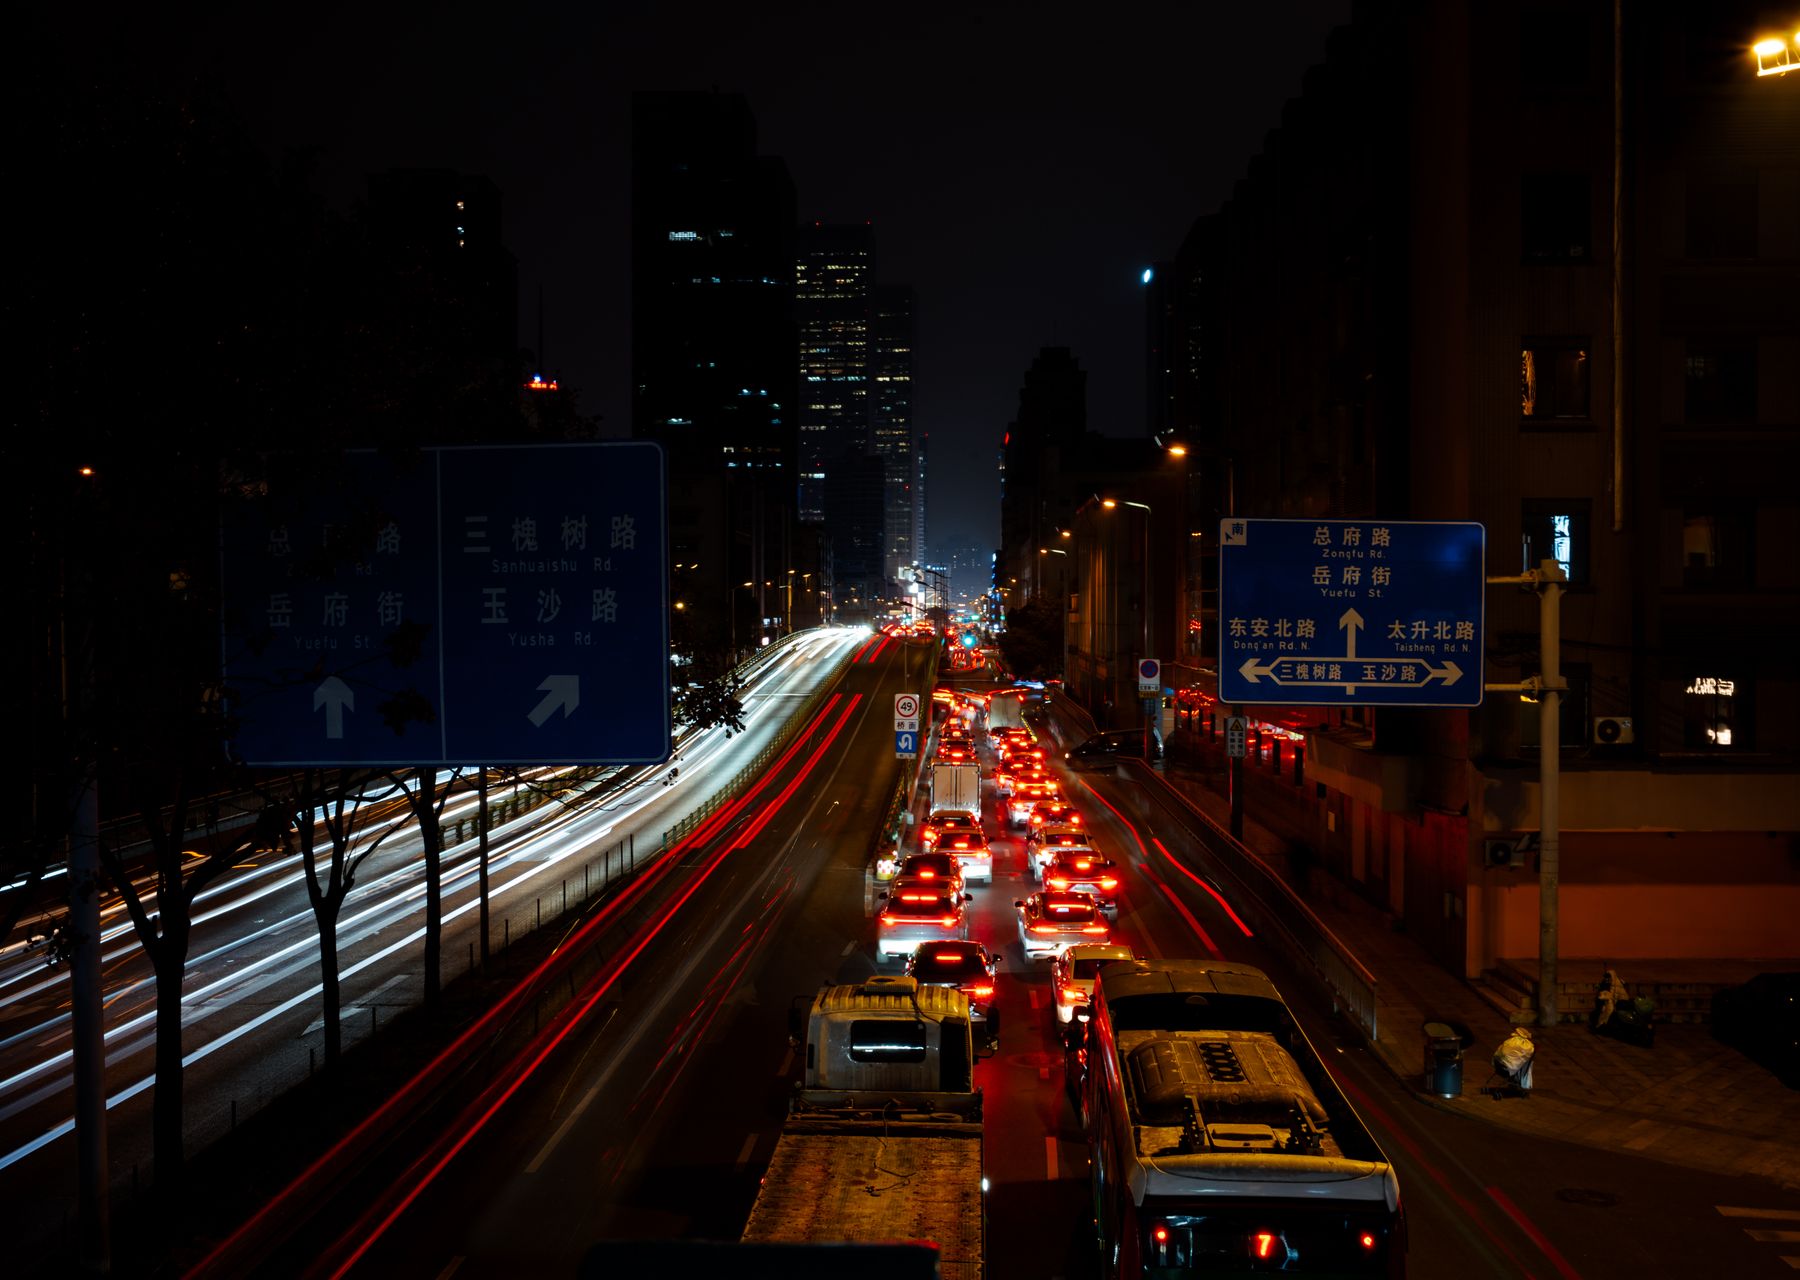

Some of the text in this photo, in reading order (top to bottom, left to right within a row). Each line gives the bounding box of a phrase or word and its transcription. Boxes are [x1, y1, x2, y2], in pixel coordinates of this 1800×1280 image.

[463, 513, 637, 553] 三槐树路
[1232, 523, 1244, 536] 南
[1312, 525, 1391, 547] 总府路
[1322, 549, 1387, 560] Zongfu Rd.
[491, 556, 618, 573] Sanhuaishu Rd.
[1312, 565, 1392, 586] 岳府街
[1320, 588, 1384, 598] Yuefu St.
[265, 591, 404, 628] 岳府街
[481, 586, 619, 624] 玉沙路
[1229, 617, 1317, 639] 东安北路
[1387, 619, 1475, 641] 太升北路
[294, 635, 337, 649] Yuefu
[508, 631, 599, 647] Yusha Rd.
[1279, 641, 1297, 651] Rd.
[1394, 642, 1435, 654] Taisheng
[1280, 663, 1342, 680] 三槐树路
[1361, 664, 1417, 681] 玉沙路
[1258, 1234, 1272, 1256] 7
